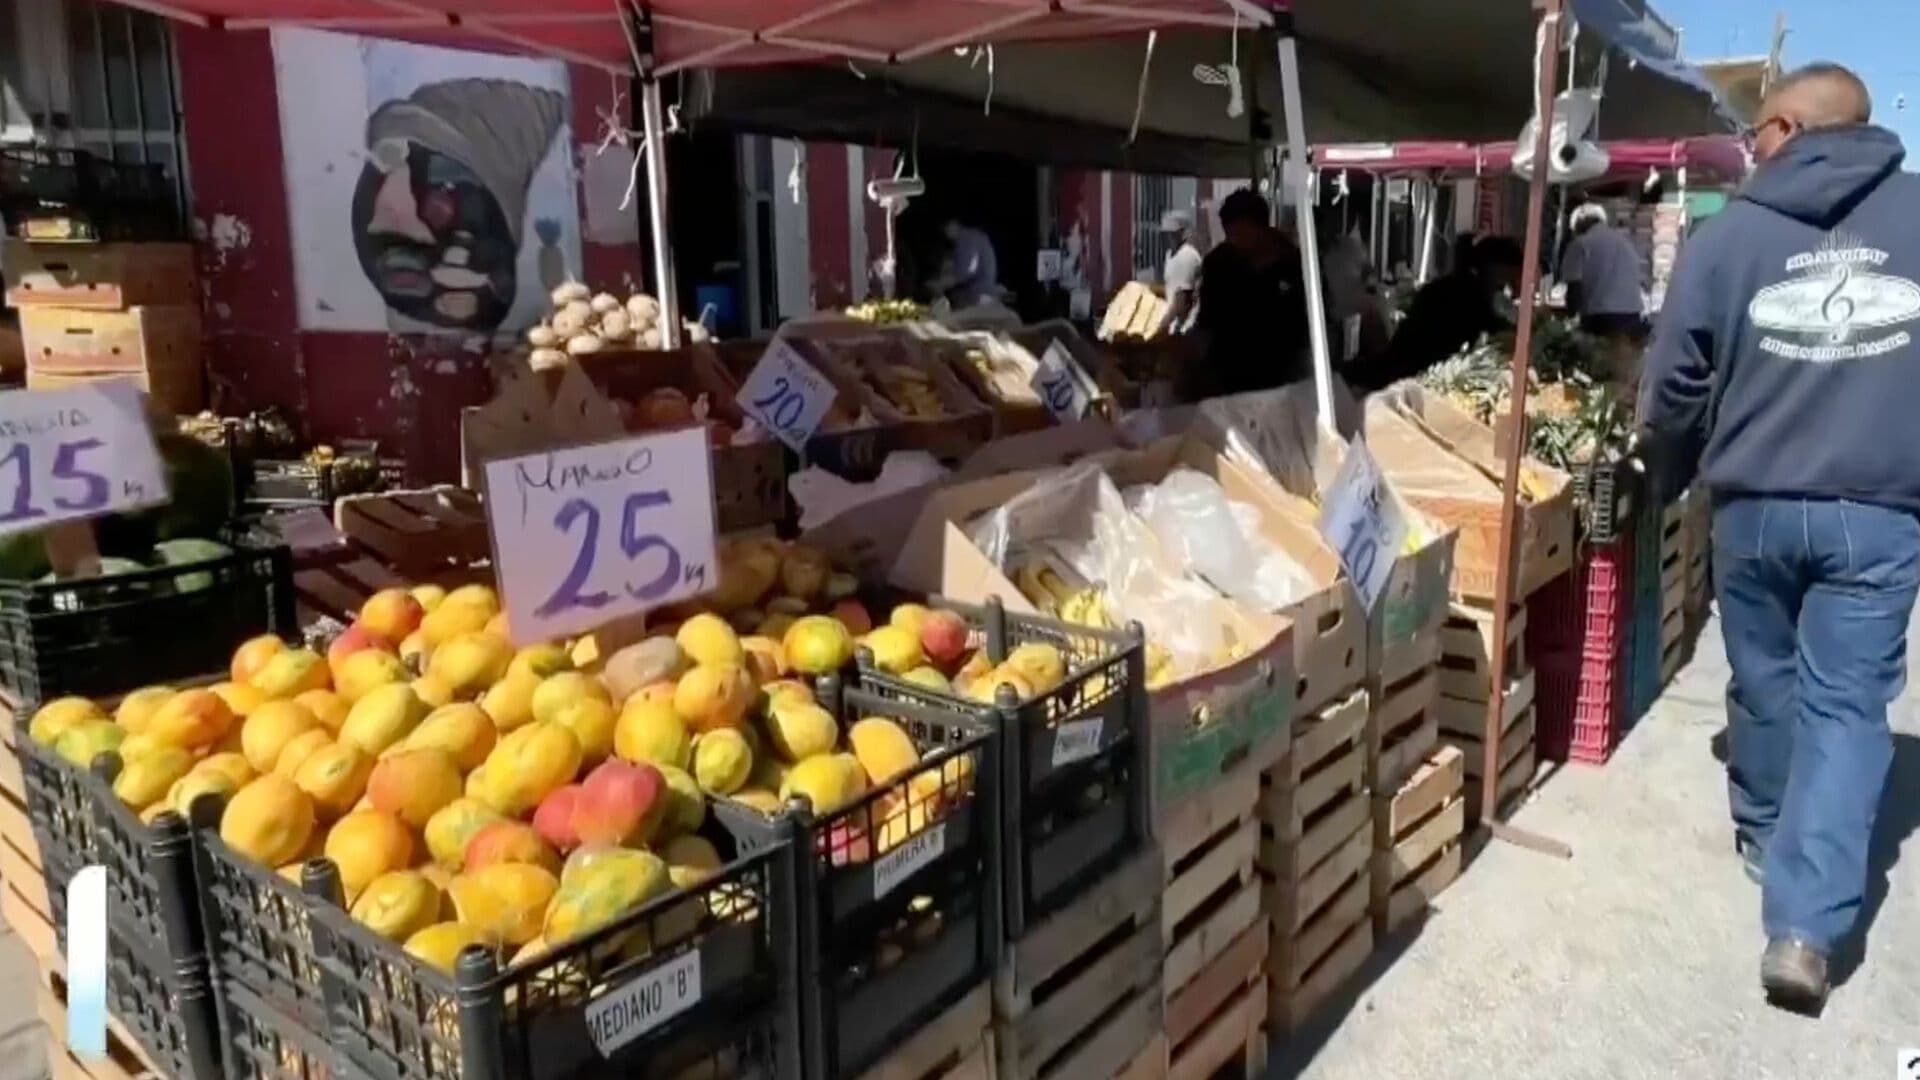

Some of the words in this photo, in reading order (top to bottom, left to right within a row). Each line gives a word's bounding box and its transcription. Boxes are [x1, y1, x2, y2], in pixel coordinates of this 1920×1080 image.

[753, 377, 805, 430] 20
[0, 437, 109, 521] 15
[532, 488, 683, 619] 25
[1341, 516, 1378, 588] 10
